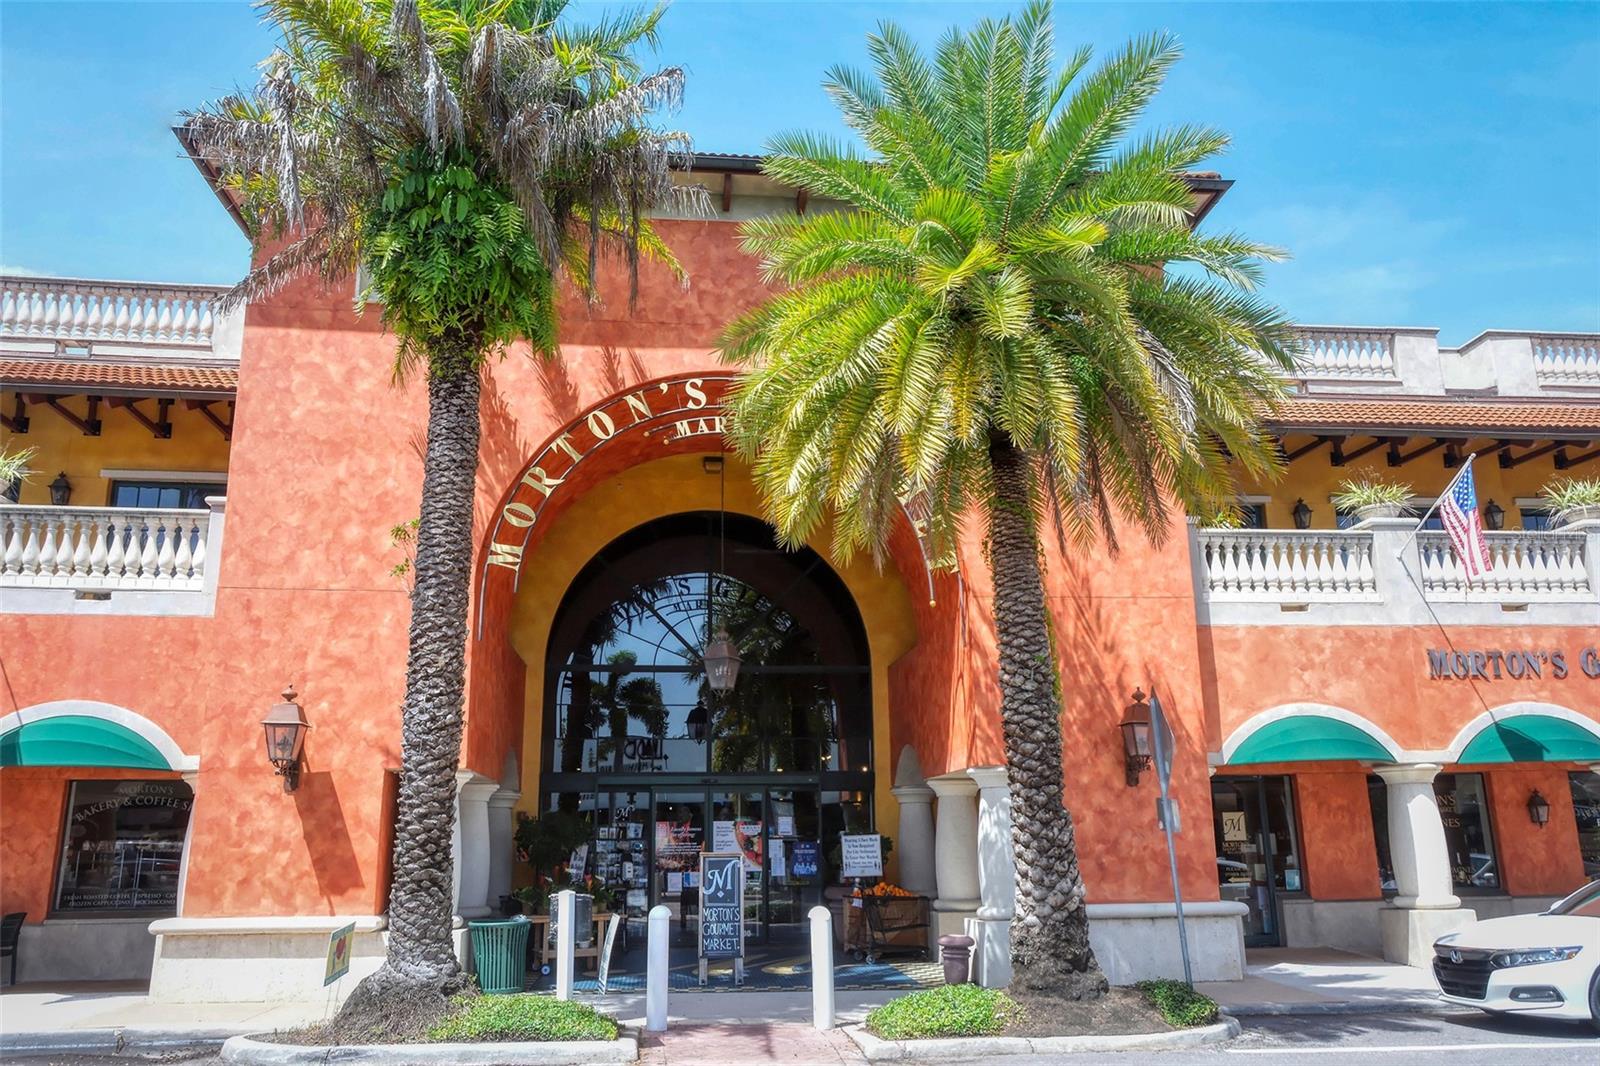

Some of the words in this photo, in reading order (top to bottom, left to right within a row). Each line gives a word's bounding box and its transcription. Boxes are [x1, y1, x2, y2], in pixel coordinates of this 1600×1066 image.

[674, 416, 728, 439] MAR
[487, 378, 707, 574] MORTON'S
[1427, 648, 1569, 682] MORTON'S
[1580, 646, 1600, 679] G
[119, 785, 174, 795] MORTON'S
[75, 799, 121, 821] BAKERY
[123, 796, 132, 807] &
[135, 795, 180, 809] COFFEE
[1442, 818, 1461, 828] NES
[703, 860, 740, 895] M
[703, 907, 740, 922] MORTON'S
[703, 922, 740, 936] GOURMET
